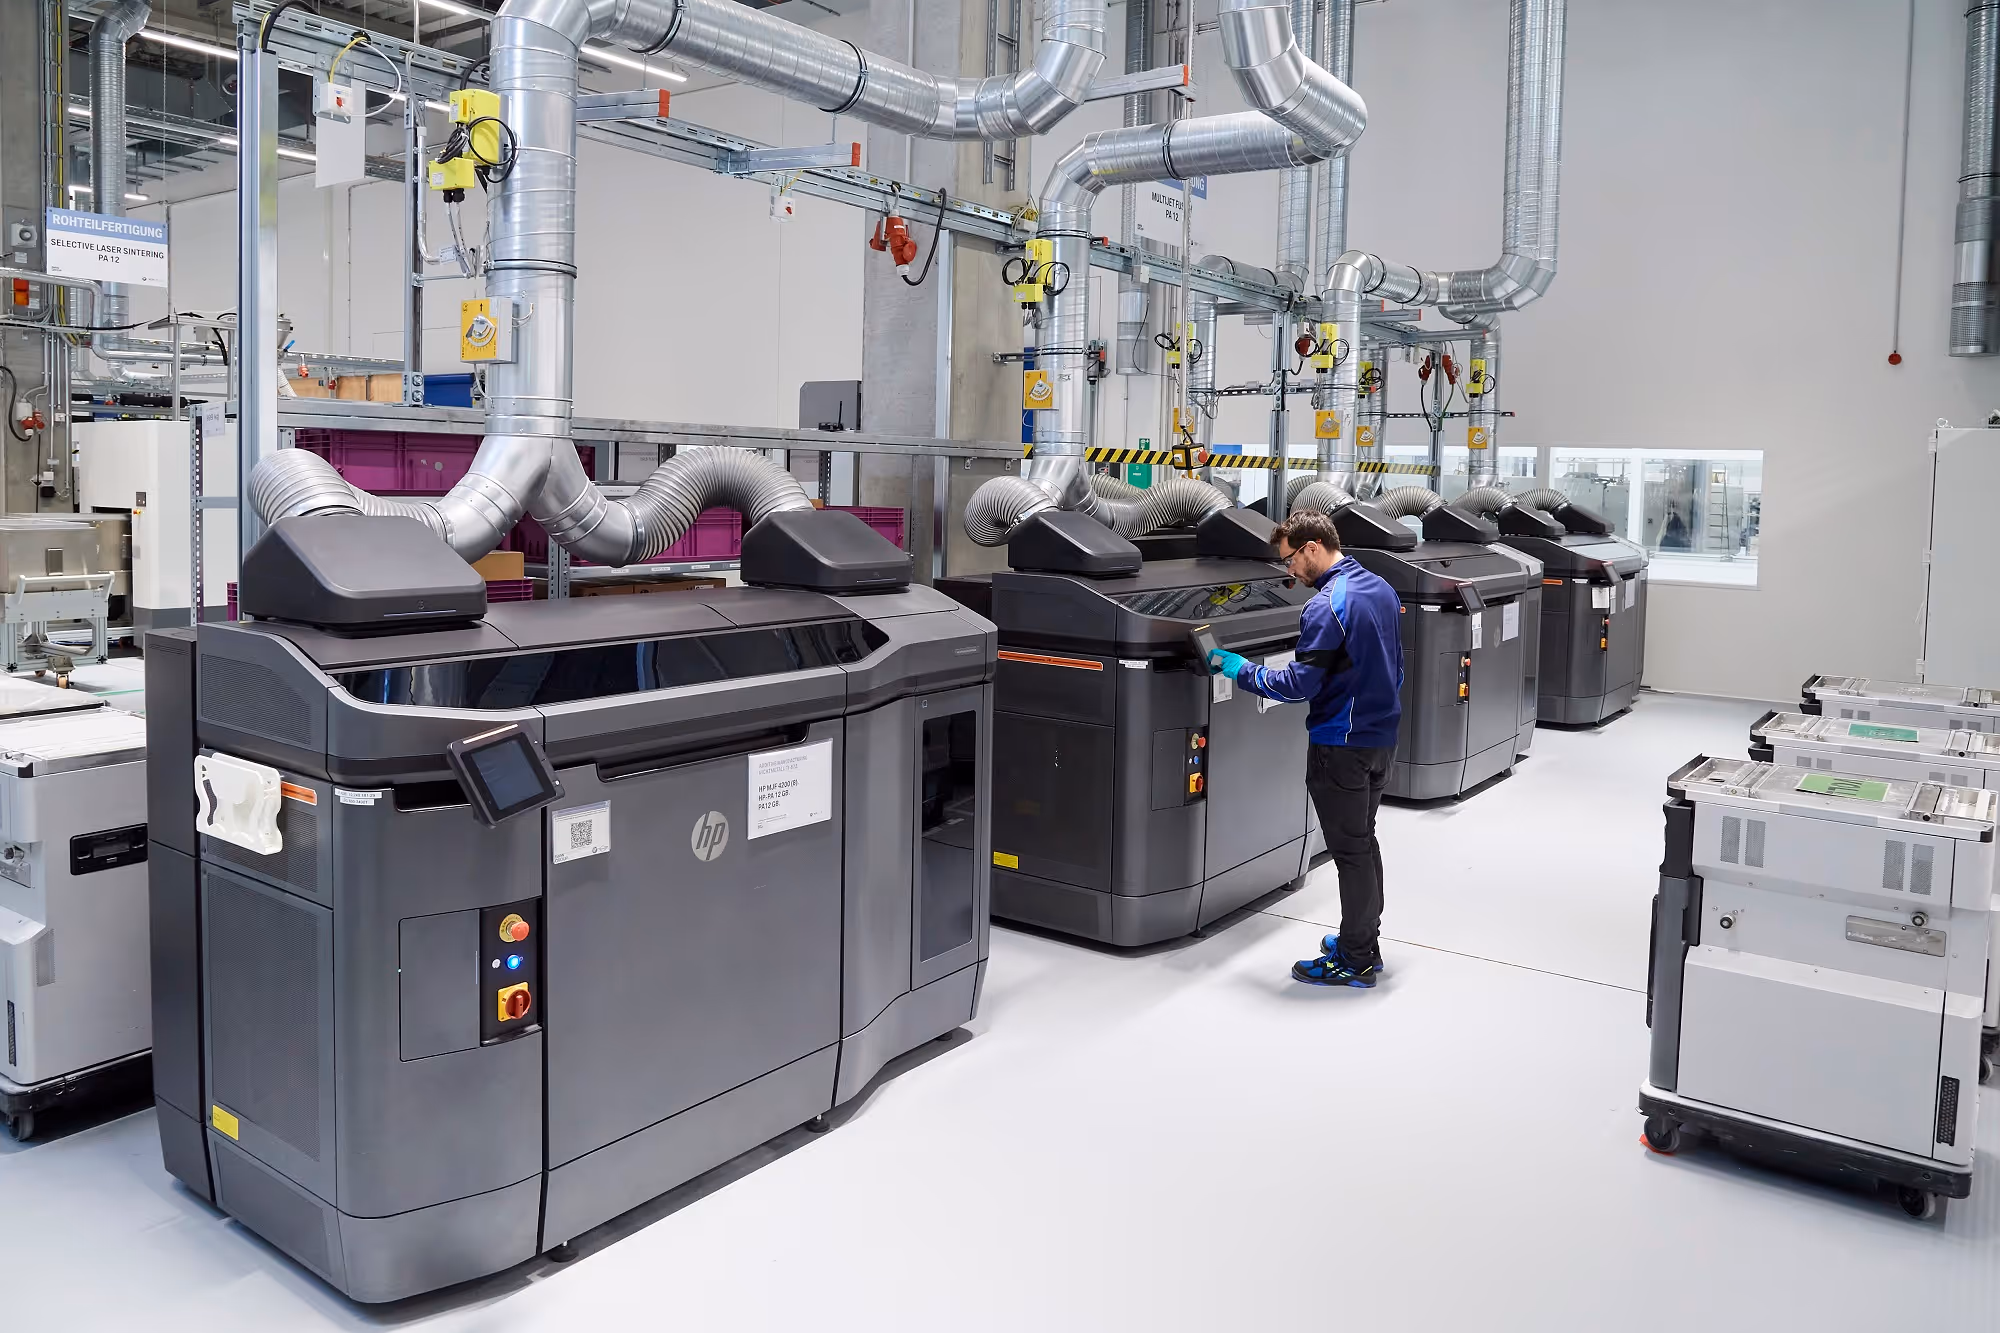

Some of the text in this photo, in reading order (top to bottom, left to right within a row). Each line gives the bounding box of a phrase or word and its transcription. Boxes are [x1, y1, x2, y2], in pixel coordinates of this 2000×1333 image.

[1152, 192, 1175, 208] MULTIJET
[1166, 210, 1179, 222] PA 12
[53, 214, 163, 239] ROHTEILFERTIGUNG
[51, 239, 164, 259] SELECTIVE LASER SINTERING
[767, 783, 777, 791] MJF
[778, 780, 790, 789] 4200
[758, 793, 774, 801] HP-PA
[696, 811, 726, 861] hp
